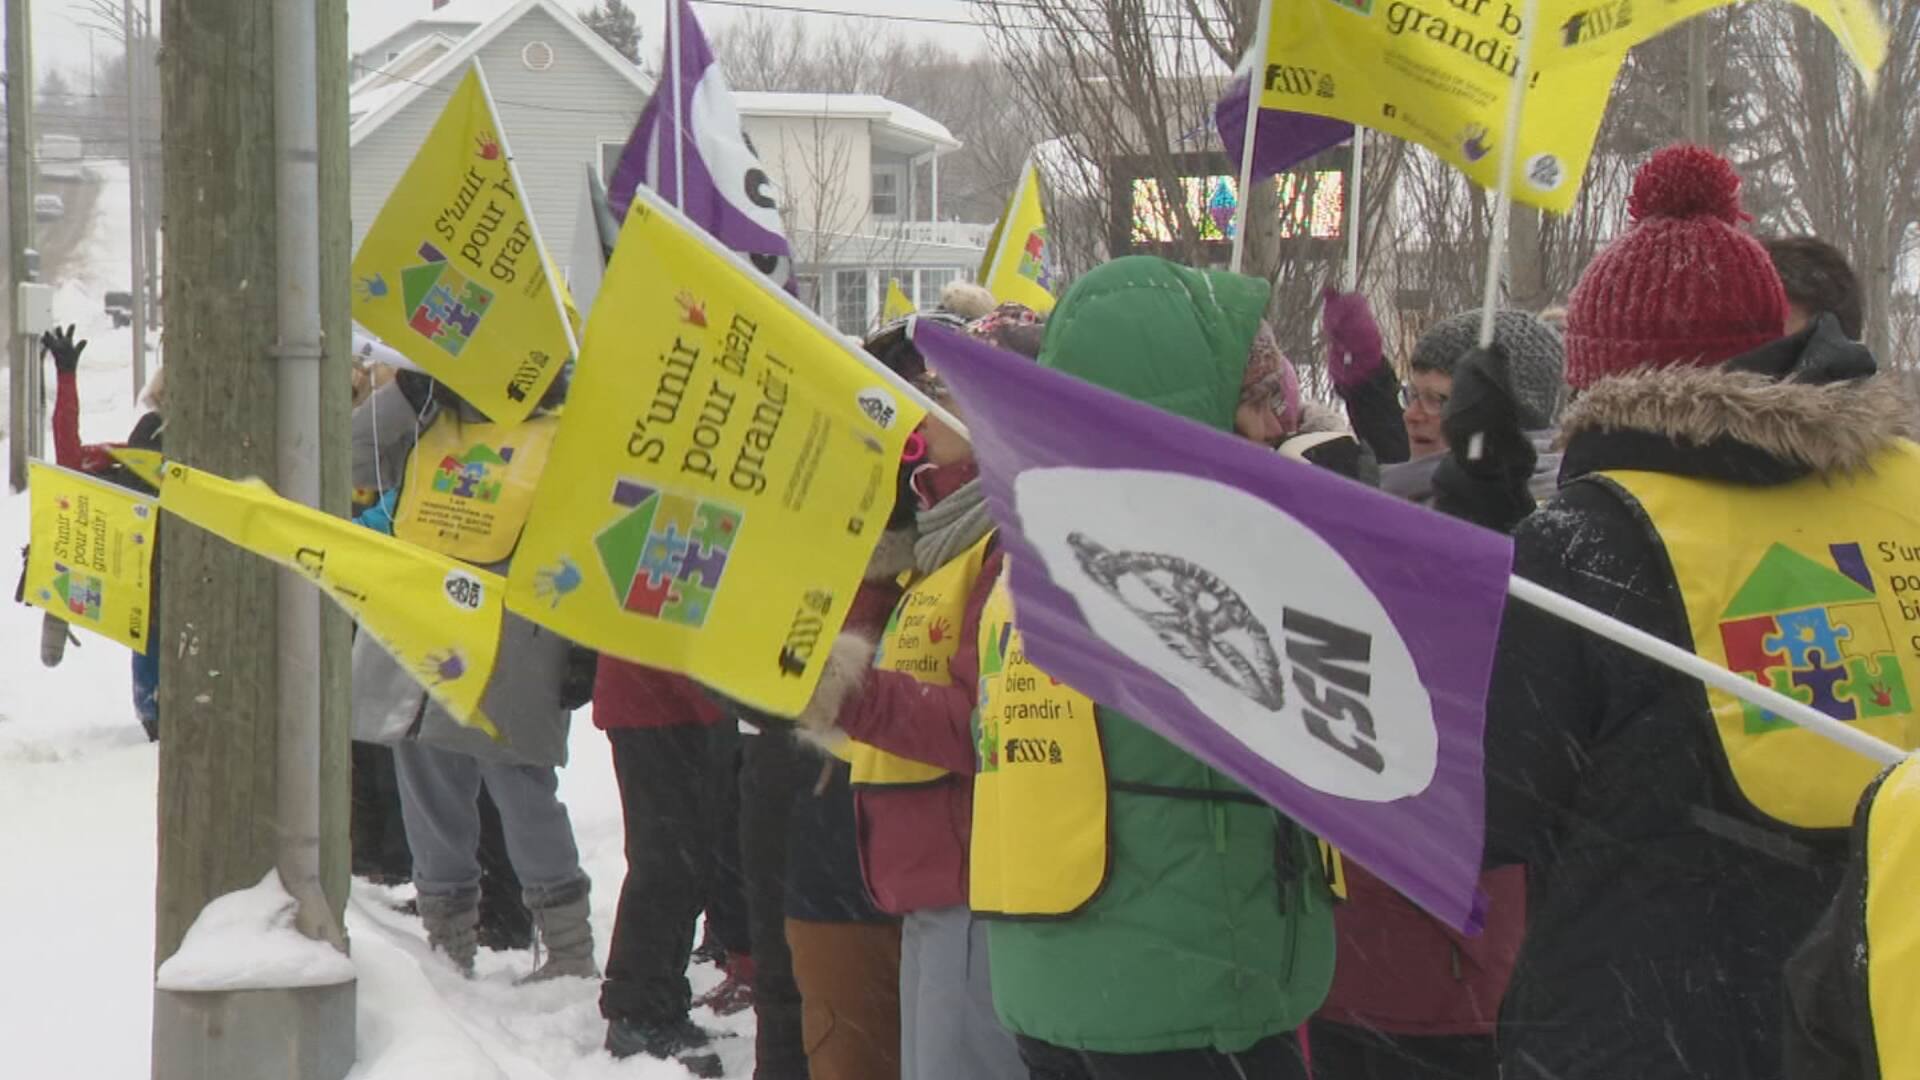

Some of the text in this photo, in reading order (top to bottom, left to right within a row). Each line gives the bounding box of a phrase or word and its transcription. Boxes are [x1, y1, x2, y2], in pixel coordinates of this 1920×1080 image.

[434, 165, 486, 242] S'unir
[460, 200, 506, 268] pour
[627, 335, 700, 463] S'unir
[680, 313, 758, 482] pour bien
[729, 368, 789, 496] grandir
[1890, 575, 1920, 598] po
[1003, 698, 1062, 725] grandir
[1005, 672, 1036, 693] bien
[1282, 605, 1386, 775] CSN
